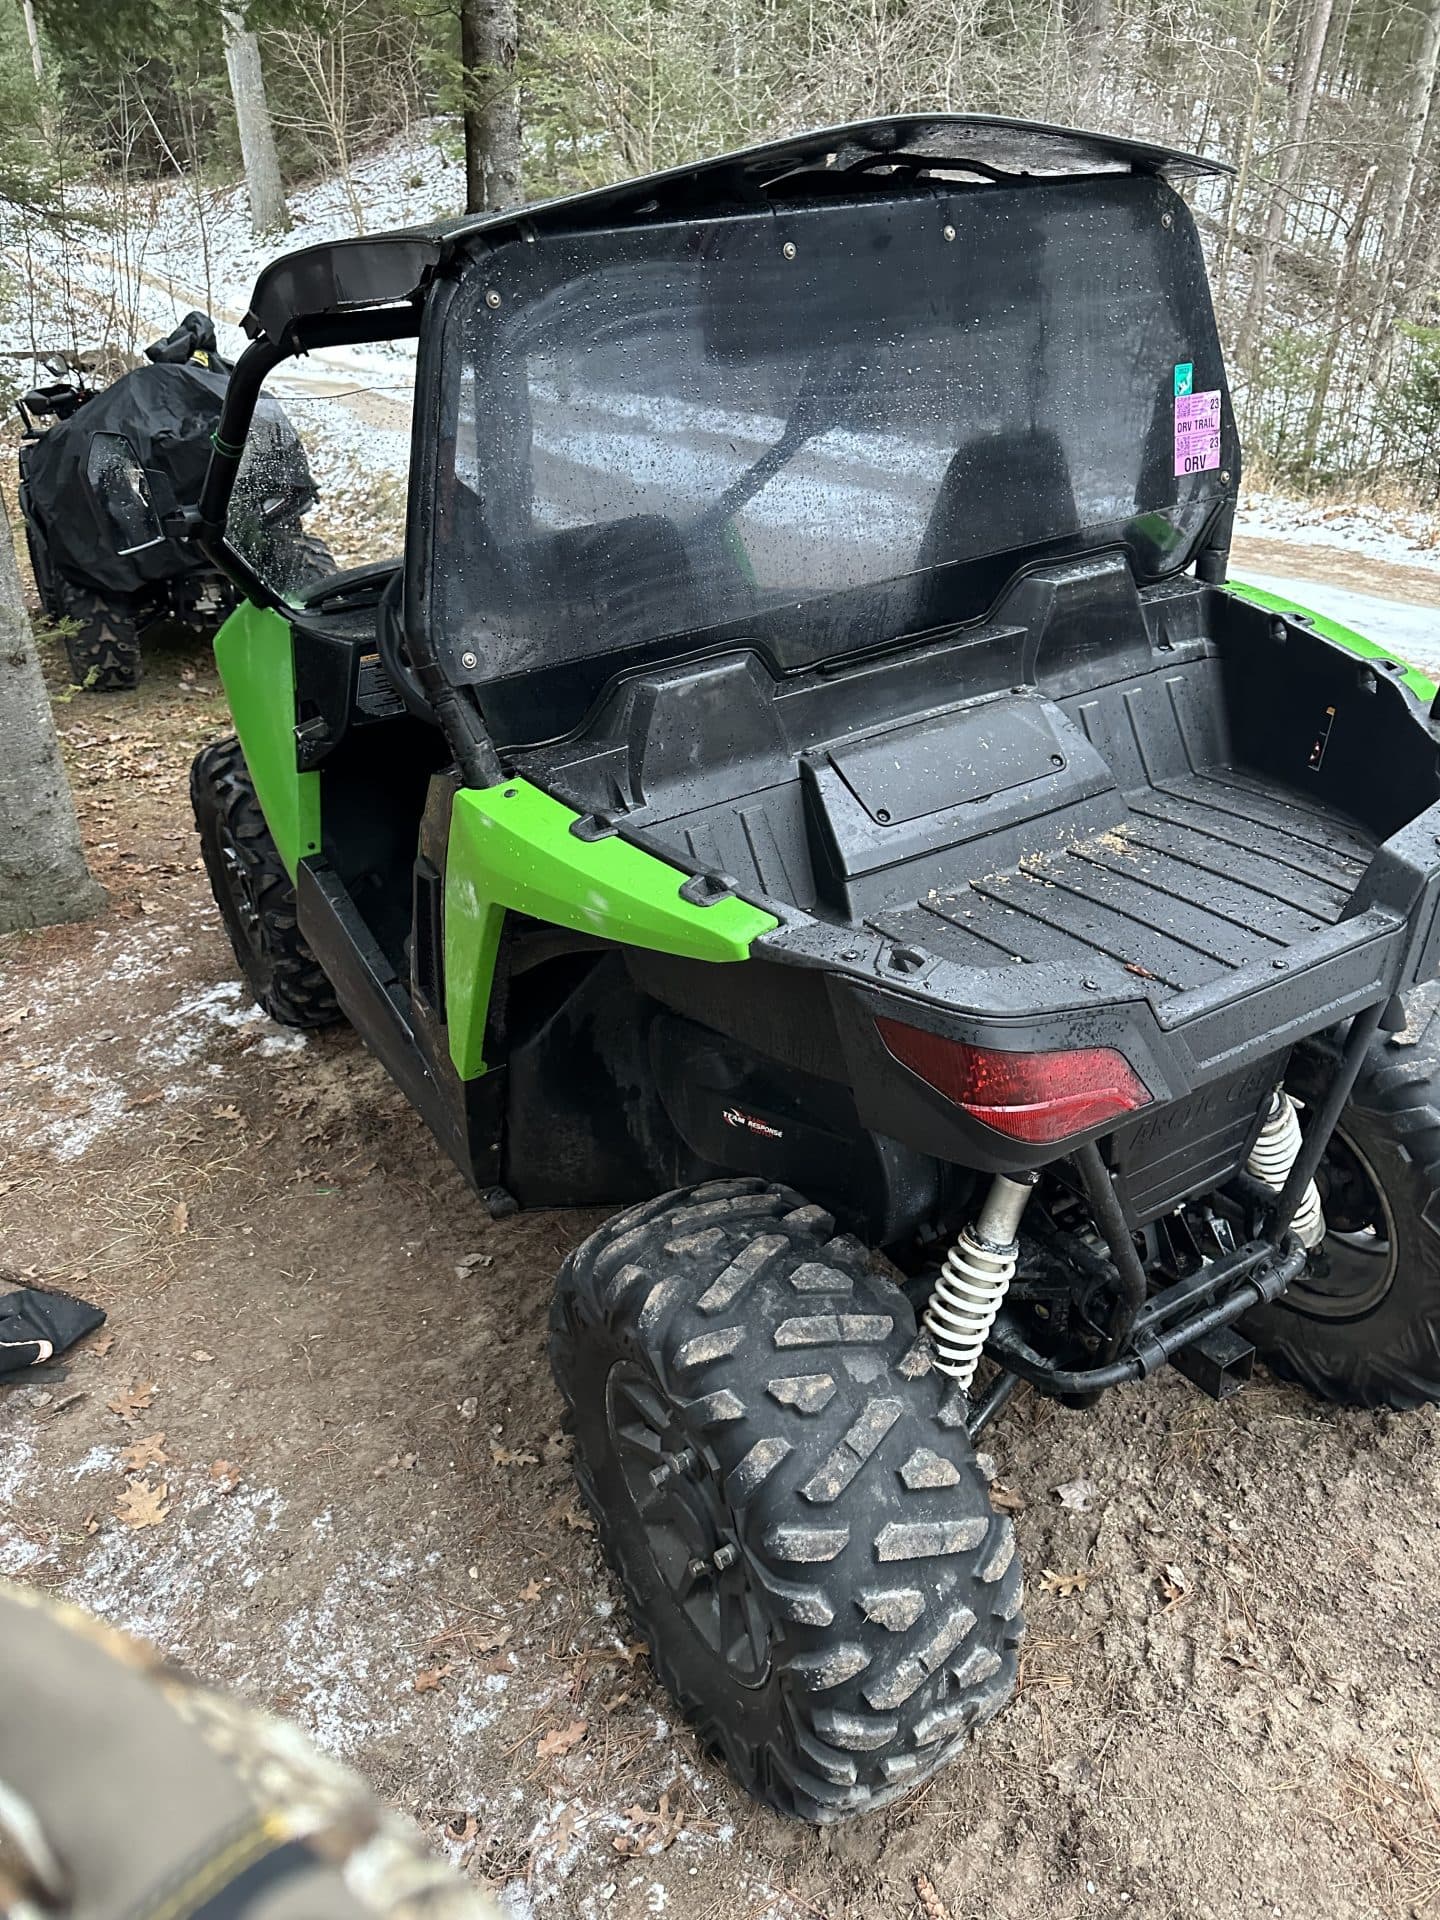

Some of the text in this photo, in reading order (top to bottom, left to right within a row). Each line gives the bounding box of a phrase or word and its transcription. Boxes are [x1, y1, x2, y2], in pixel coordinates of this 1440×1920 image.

[1210, 398, 1219, 409] 23
[1177, 418, 1215, 433] ORV TRAIL
[1209, 437, 1219, 448] 23
[1184, 454, 1206, 472] ORV
